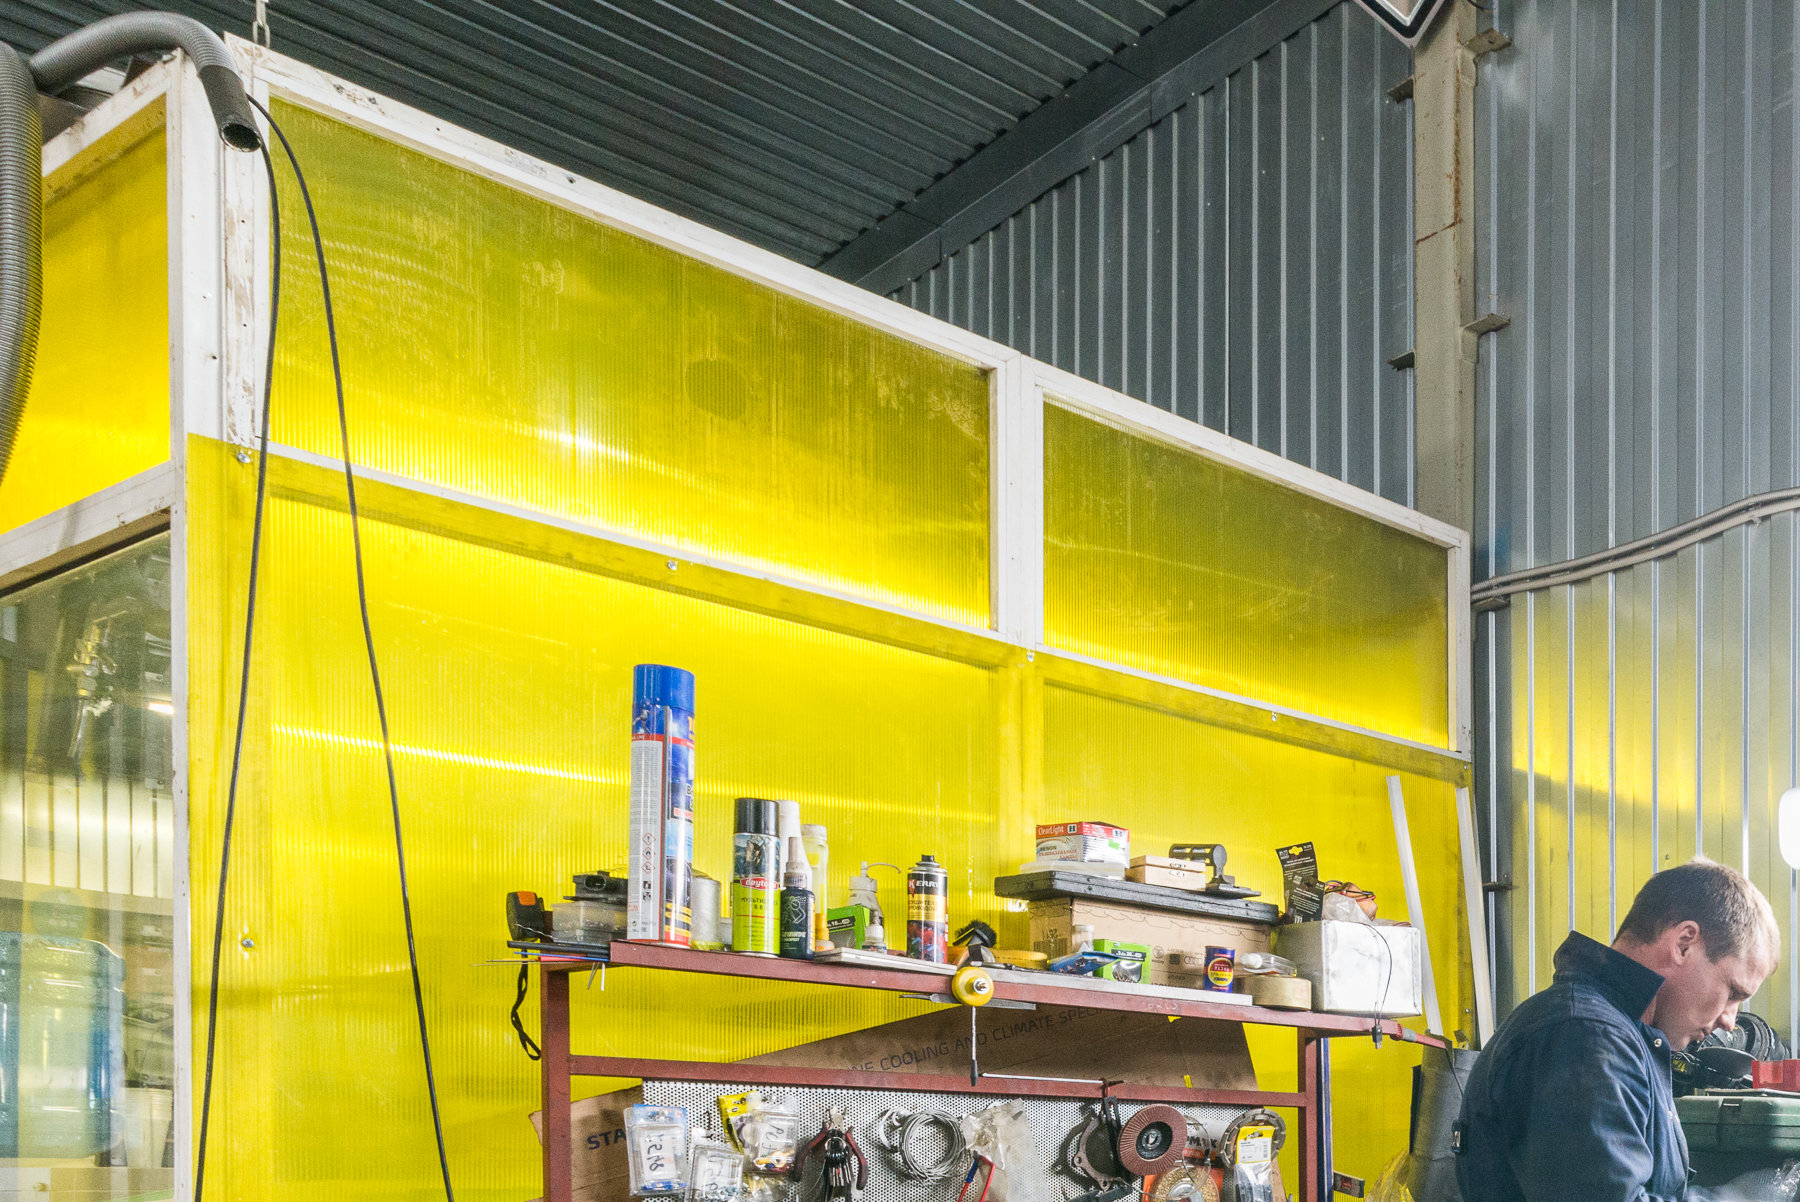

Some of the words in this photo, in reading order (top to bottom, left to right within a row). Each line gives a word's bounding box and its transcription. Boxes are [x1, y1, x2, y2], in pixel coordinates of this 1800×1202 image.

[1038, 825, 1064, 836] ClearLight
[745, 878, 776, 889] daytoa
[880, 1040, 950, 1071] COOLING
[955, 1031, 987, 1052] AND
[992, 1015, 1055, 1042] CLIMATE
